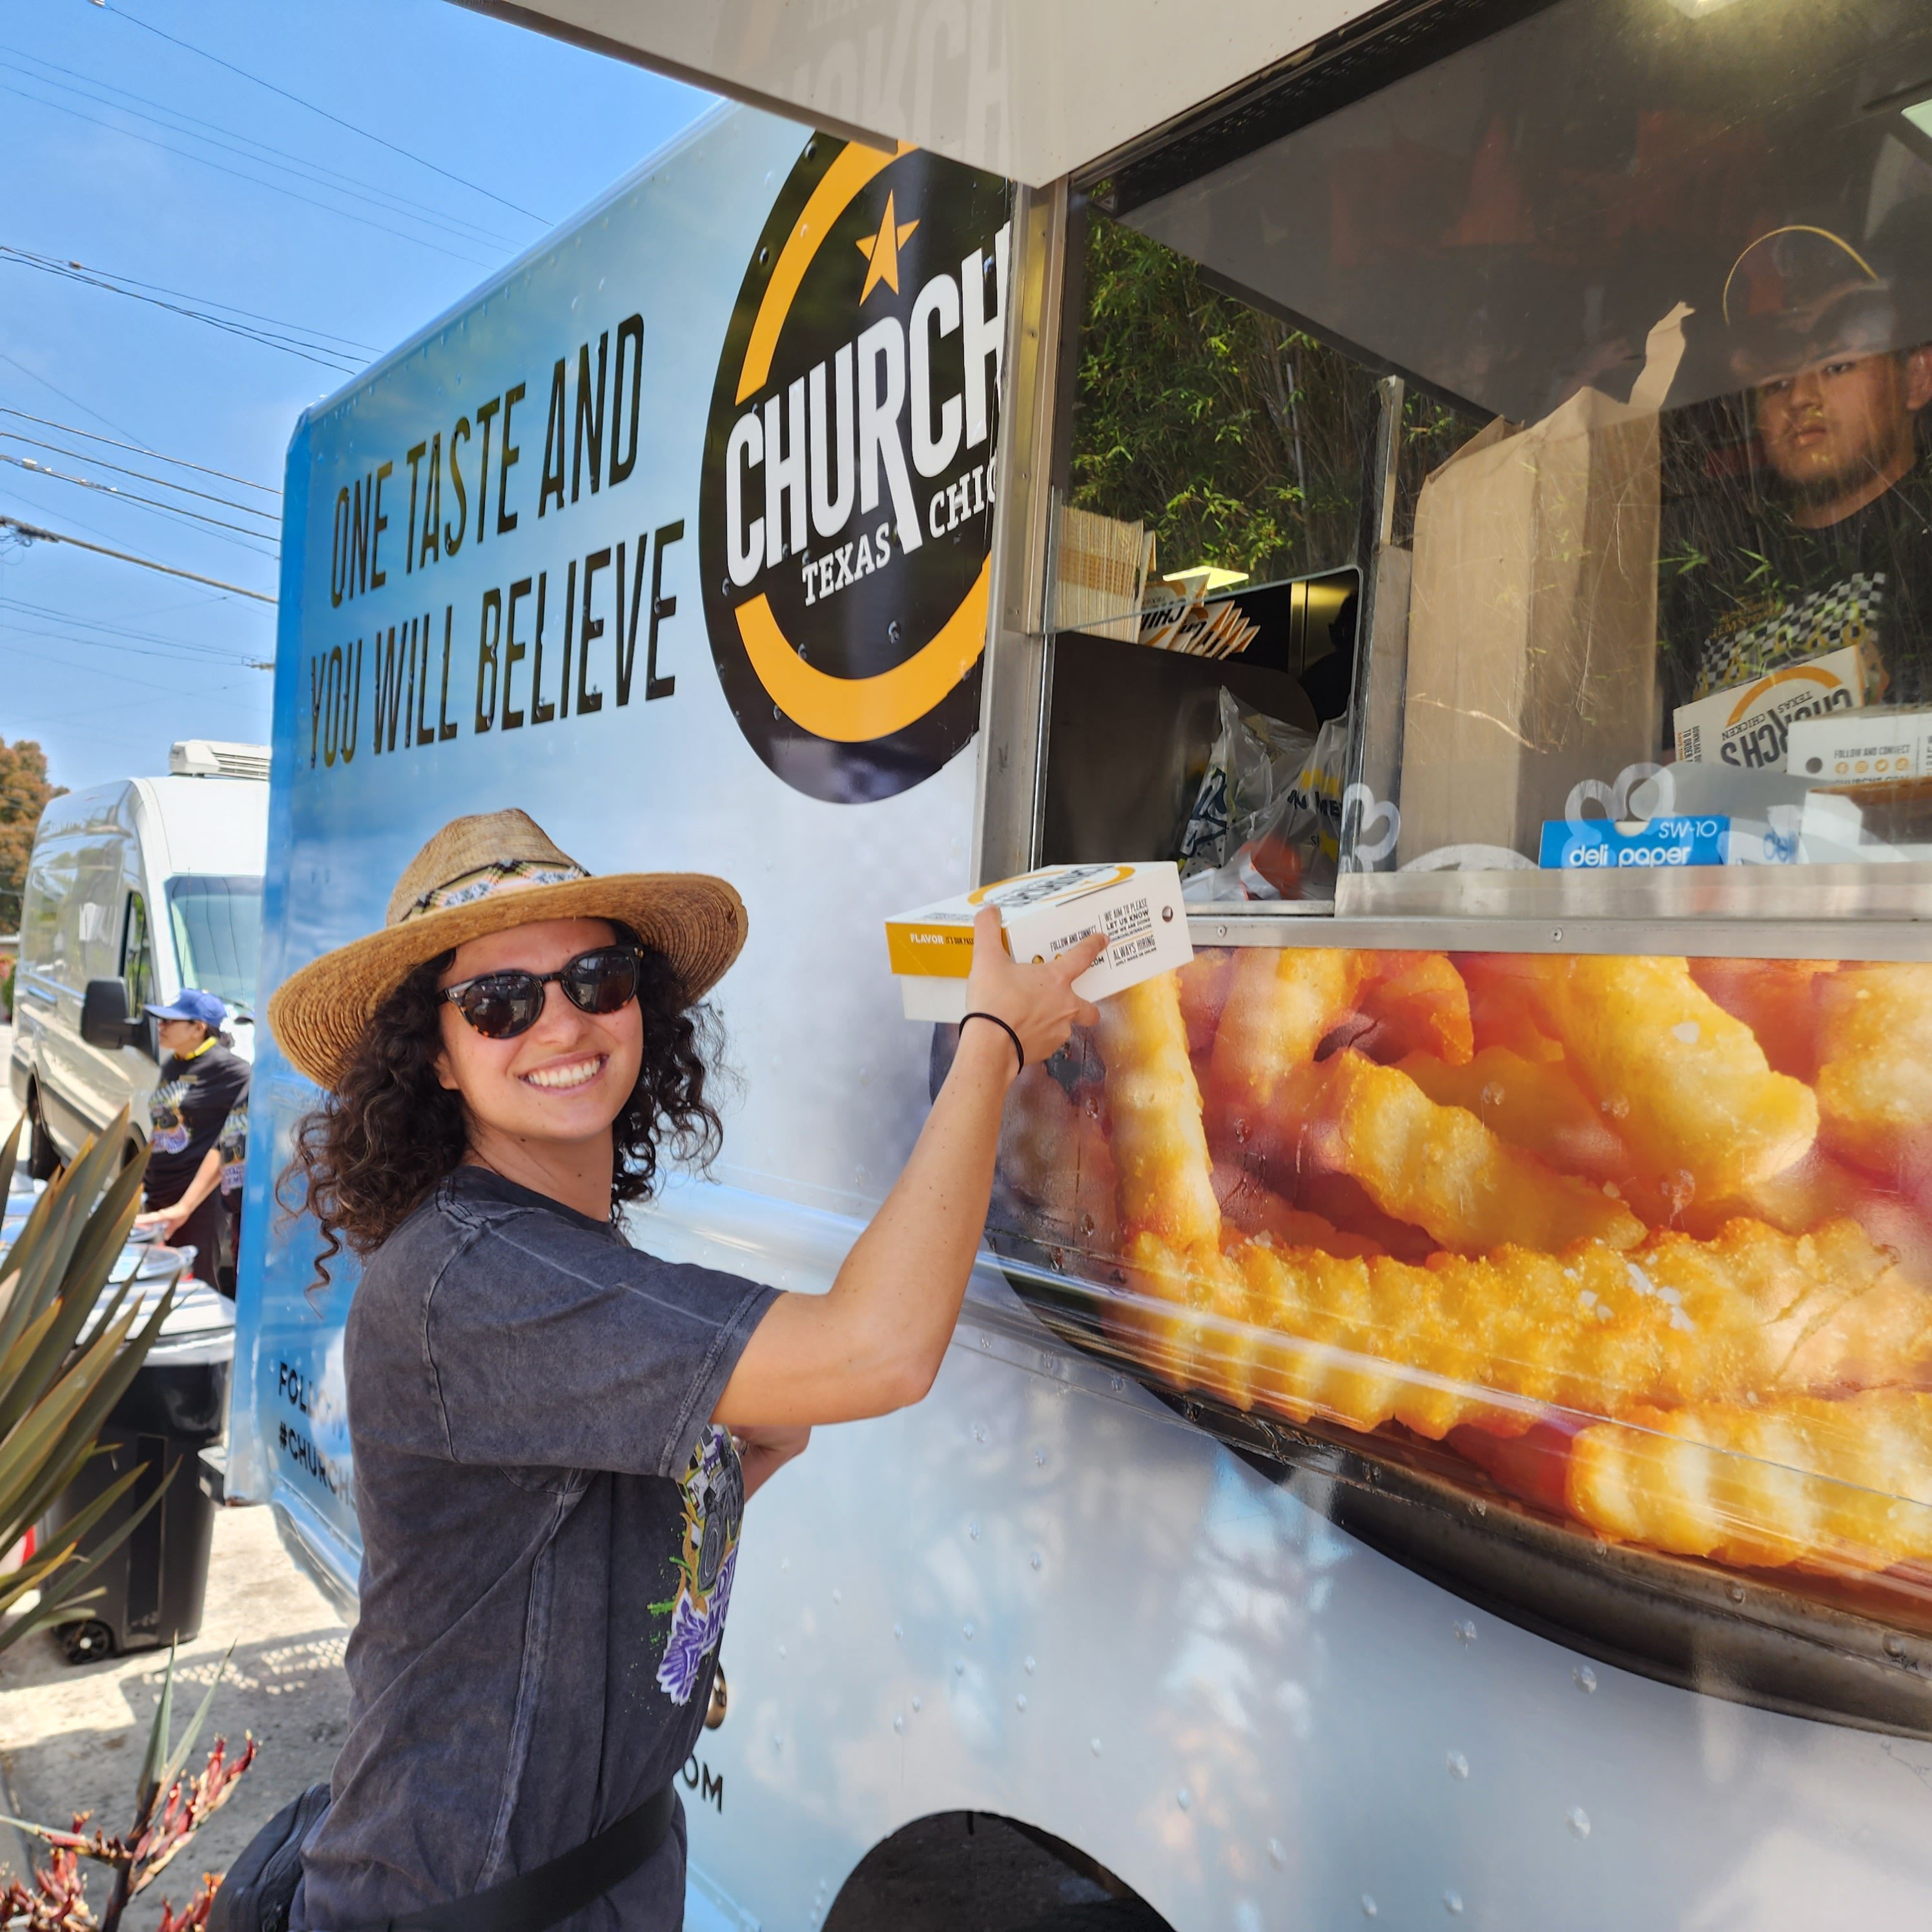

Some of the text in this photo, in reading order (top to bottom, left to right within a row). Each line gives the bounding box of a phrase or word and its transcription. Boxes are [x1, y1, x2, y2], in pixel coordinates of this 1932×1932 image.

[331, 313, 644, 608] ONE TASTE AND
[802, 522, 890, 606] TEXAS
[311, 519, 684, 769] YOU WILL BELIEVE
[1721, 690, 1813, 741] CHICKEN TEXAS
[1834, 749, 1861, 758] FOLLOW
[1863, 747, 1877, 756] AND
[1659, 821, 1718, 839] SW-10
[1569, 845, 1690, 867] deli paper
[1106, 921, 1119, 930] LET
[1129, 909, 1149, 921] KNOW
[910, 933, 944, 945] FLAVOR
[1050, 935, 1069, 952] FOLLOW
[1069, 932, 1078, 943] AND
[1113, 934, 1156, 961] ALWAYS HIRING
